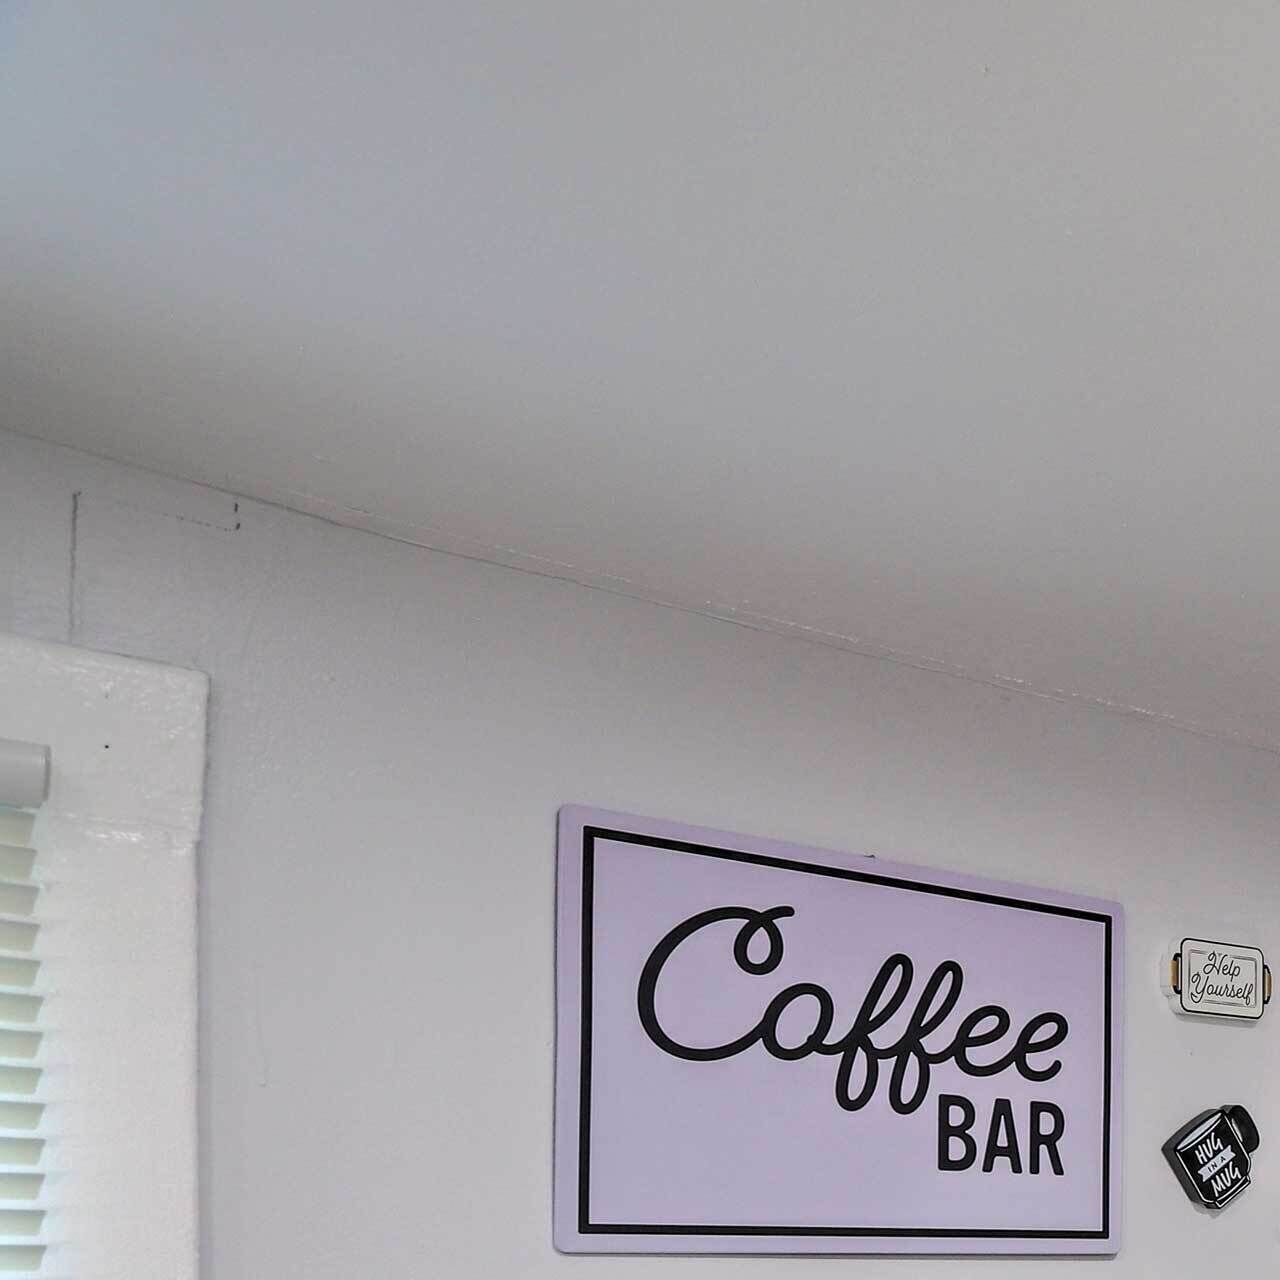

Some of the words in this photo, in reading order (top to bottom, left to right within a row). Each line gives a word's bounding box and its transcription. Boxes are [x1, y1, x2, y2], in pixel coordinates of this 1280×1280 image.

[1203, 950, 1241, 982] Help
[1190, 972, 1254, 1006] Yourself
[637, 905, 1069, 1115] Coffee
[937, 1094, 1065, 1176] BAR
[1194, 1132, 1224, 1164] HUG
[1207, 1162, 1218, 1173] IN
[1211, 1161, 1242, 1197] MUG
